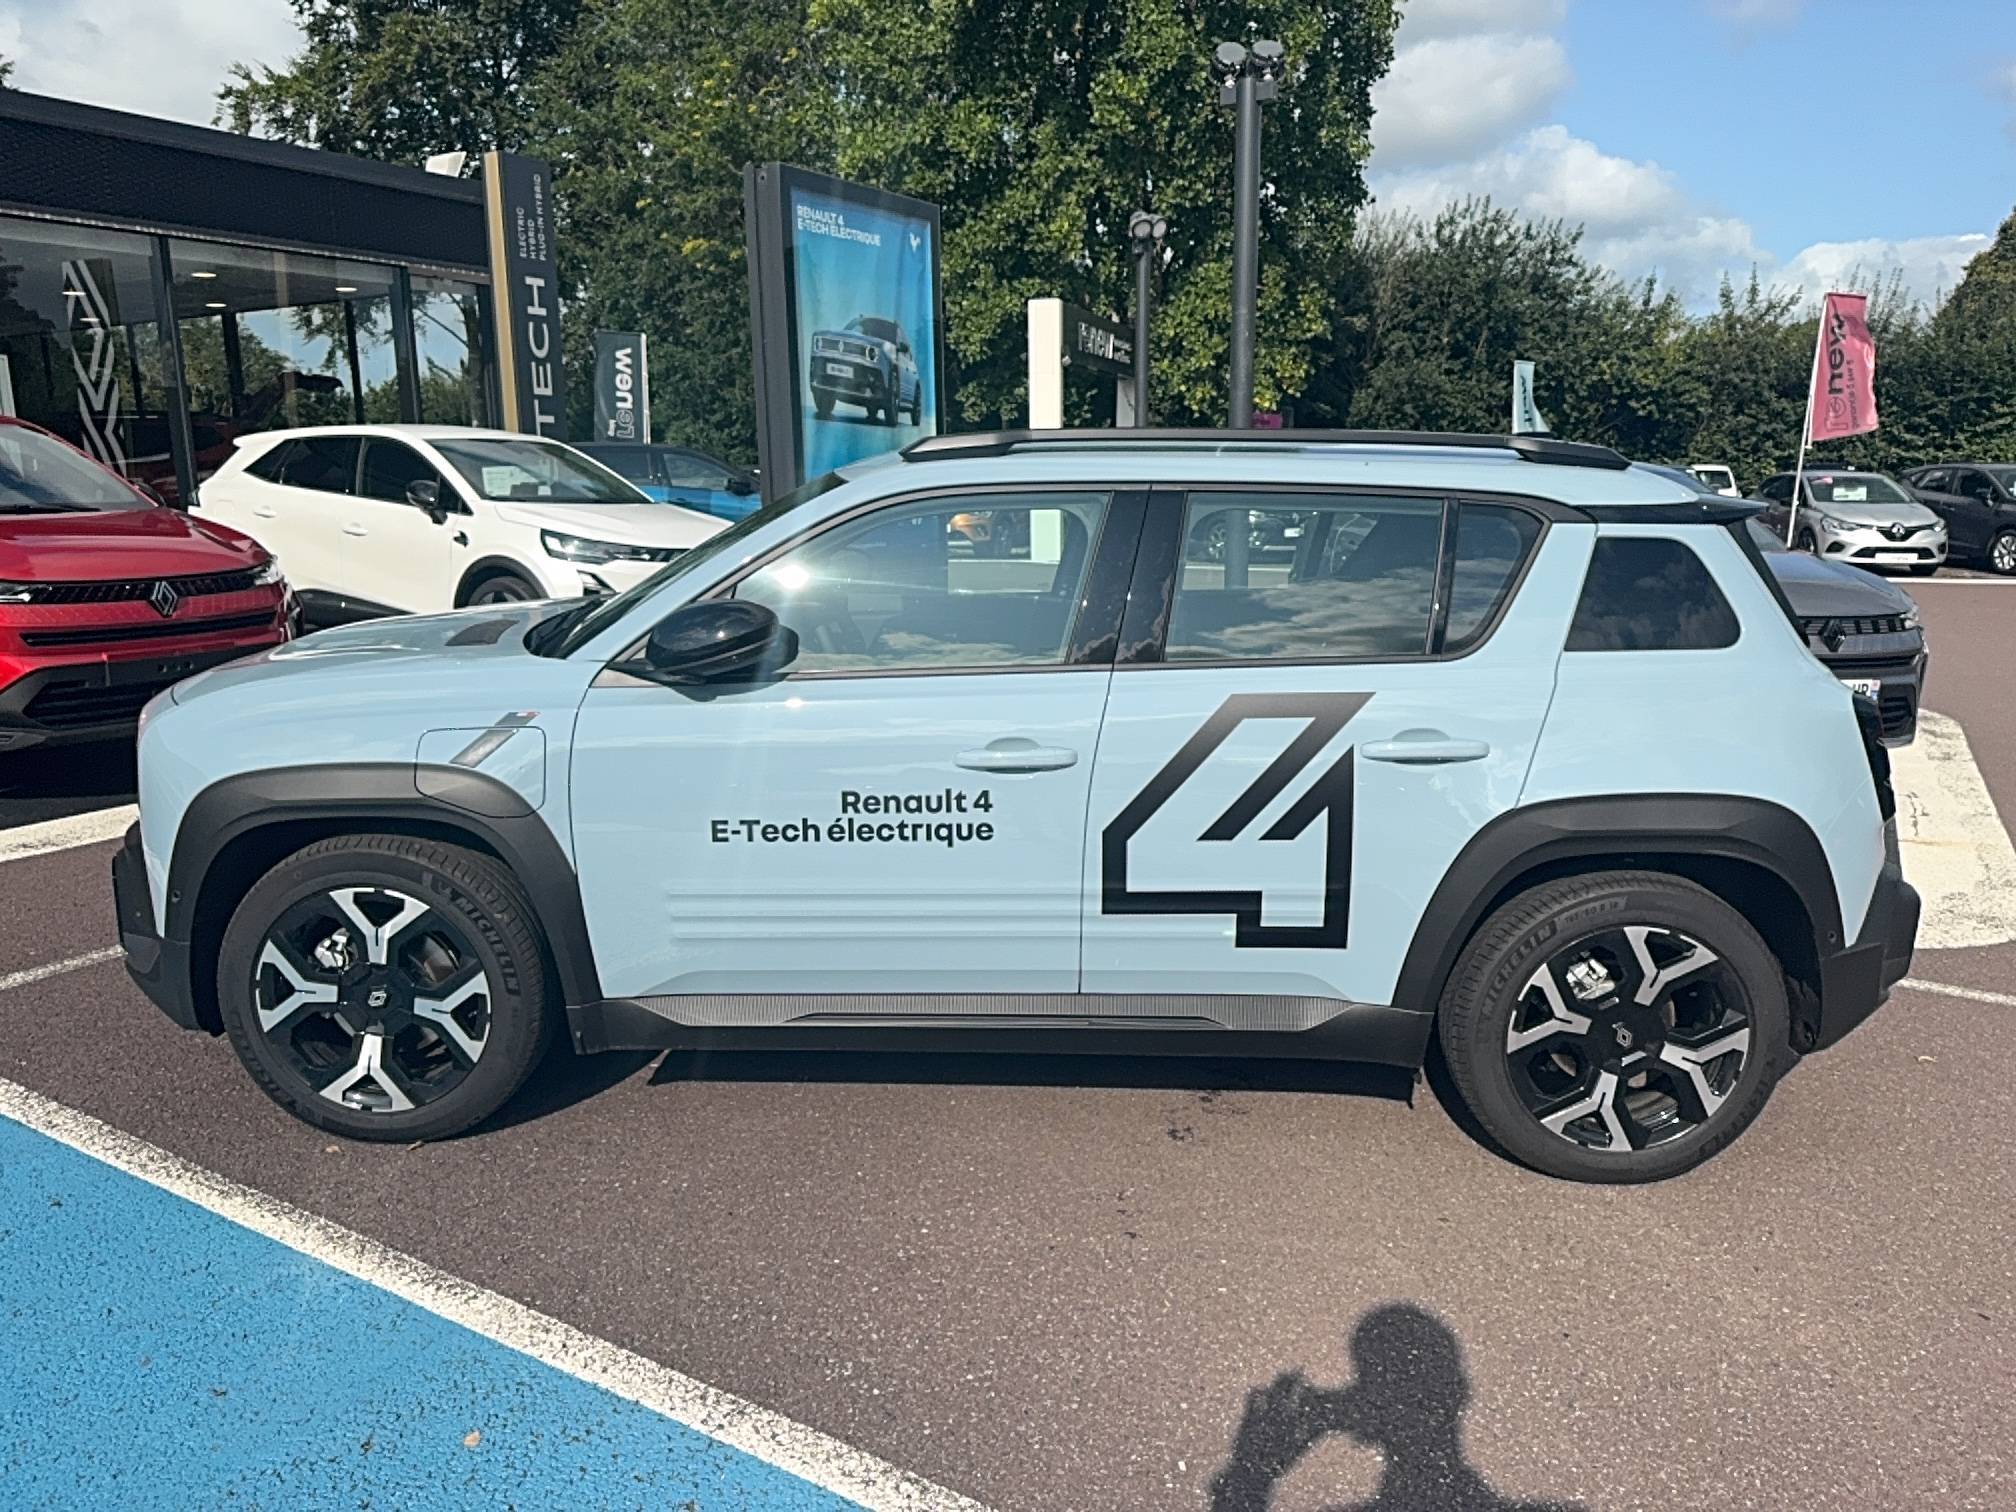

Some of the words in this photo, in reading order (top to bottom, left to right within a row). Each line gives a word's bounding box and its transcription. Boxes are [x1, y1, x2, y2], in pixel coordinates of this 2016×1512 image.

[533, 173, 544, 215] HYBRID
[515, 206, 528, 258] ELECTRIC
[797, 205, 837, 224] RENAULT
[797, 217, 829, 236] E-TECH
[527, 218, 537, 260] HYBRID
[524, 276, 556, 436] TECH
[841, 788, 968, 814] Renault
[973, 789, 993, 813] 4
[711, 817, 821, 843] E-Tech
[827, 818, 994, 848] électrique
